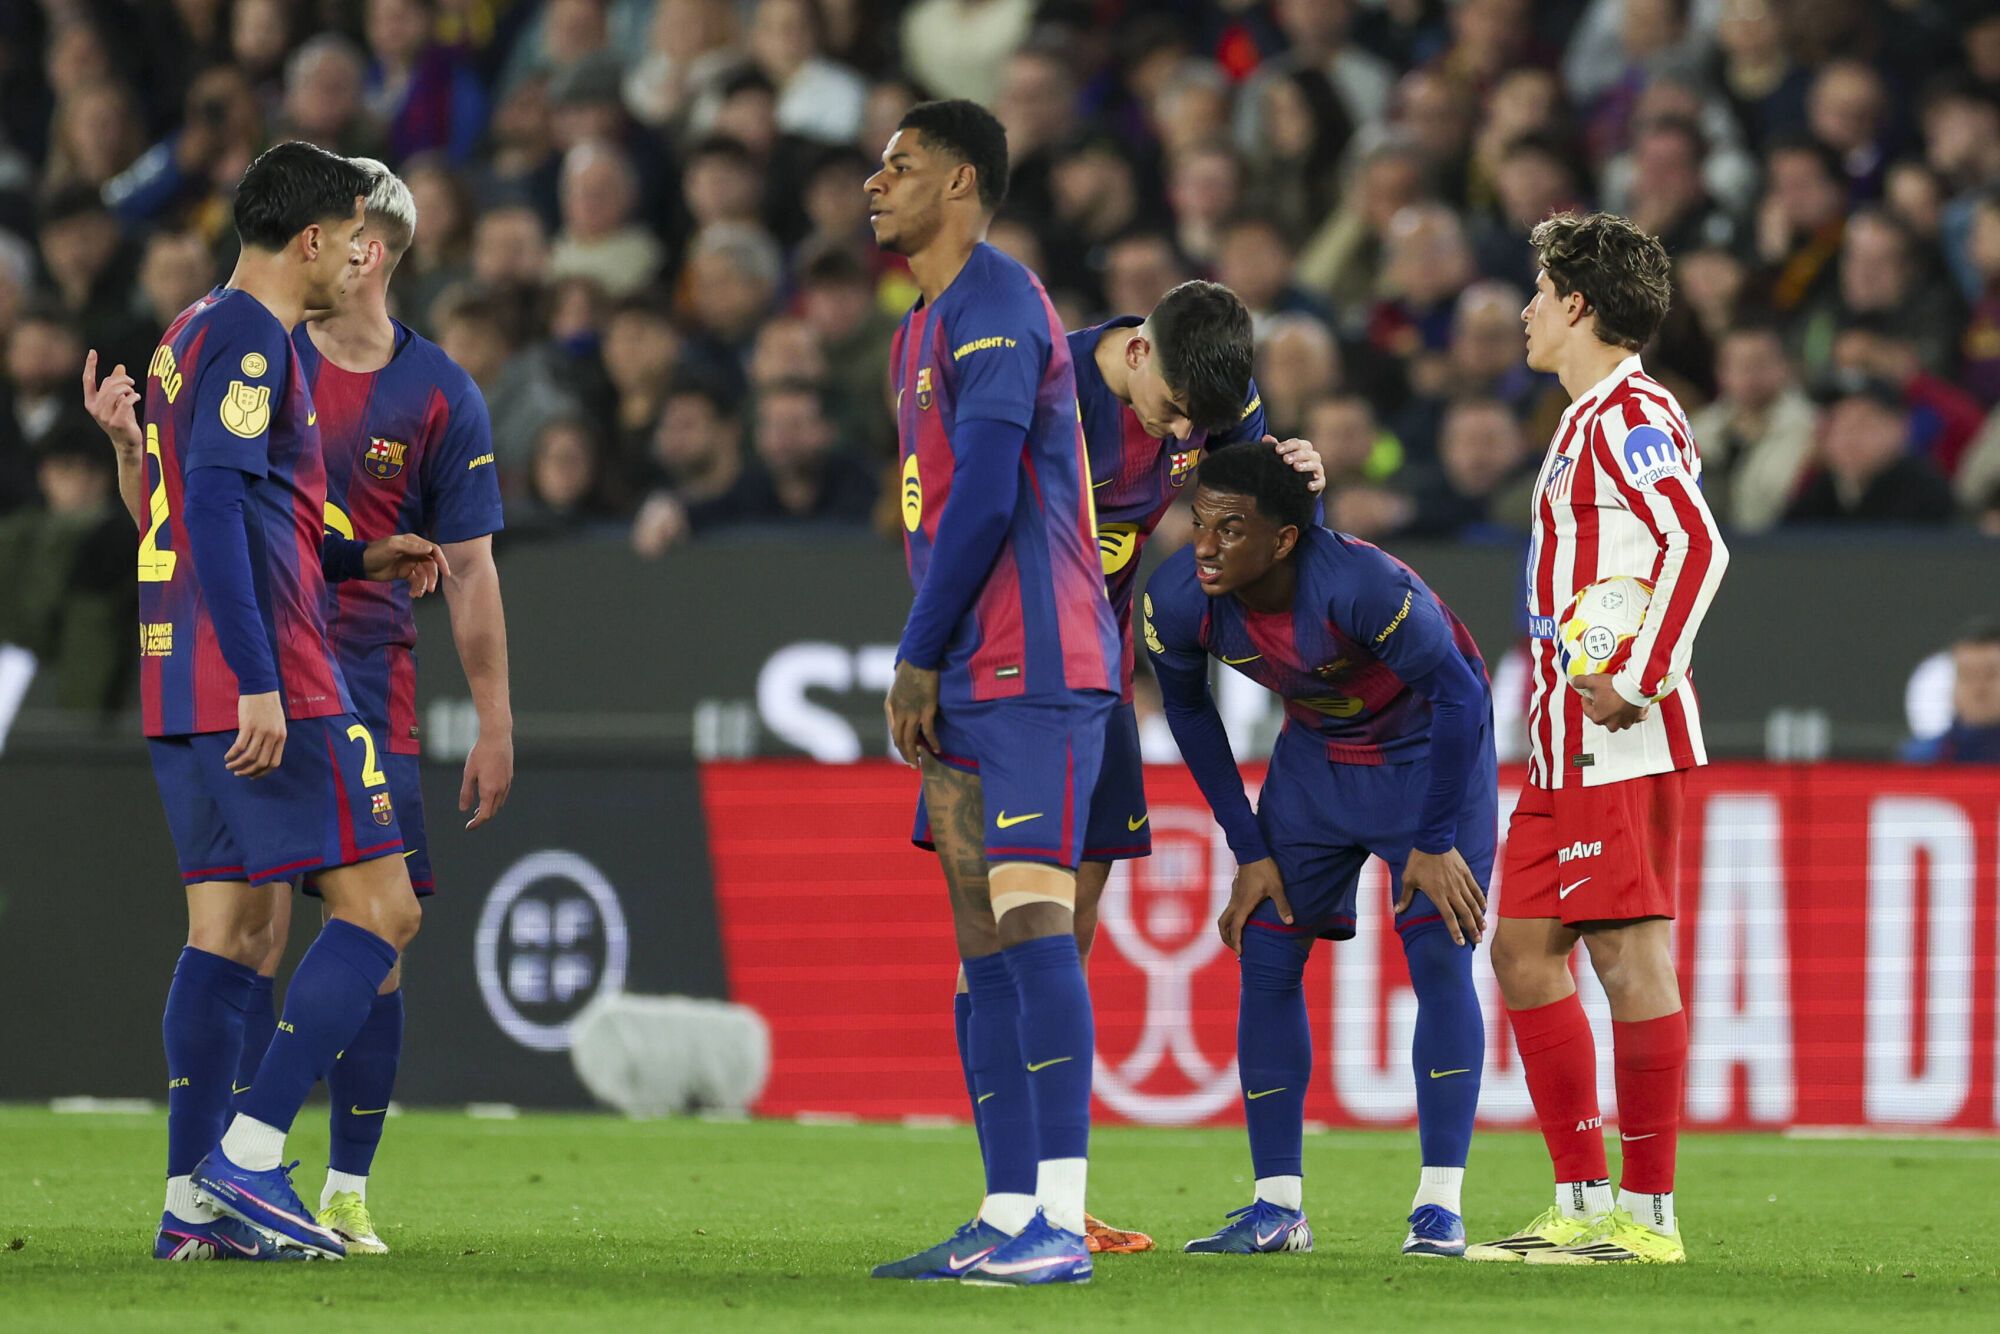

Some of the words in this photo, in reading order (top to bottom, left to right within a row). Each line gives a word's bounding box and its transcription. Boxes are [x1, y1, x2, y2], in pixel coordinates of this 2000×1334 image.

[247, 360, 261, 369] 32
[1635, 465, 1683, 488] kraken
[138, 423, 177, 582] 2
[1535, 618, 1553, 637] AIR
[346, 724, 386, 788] 2
